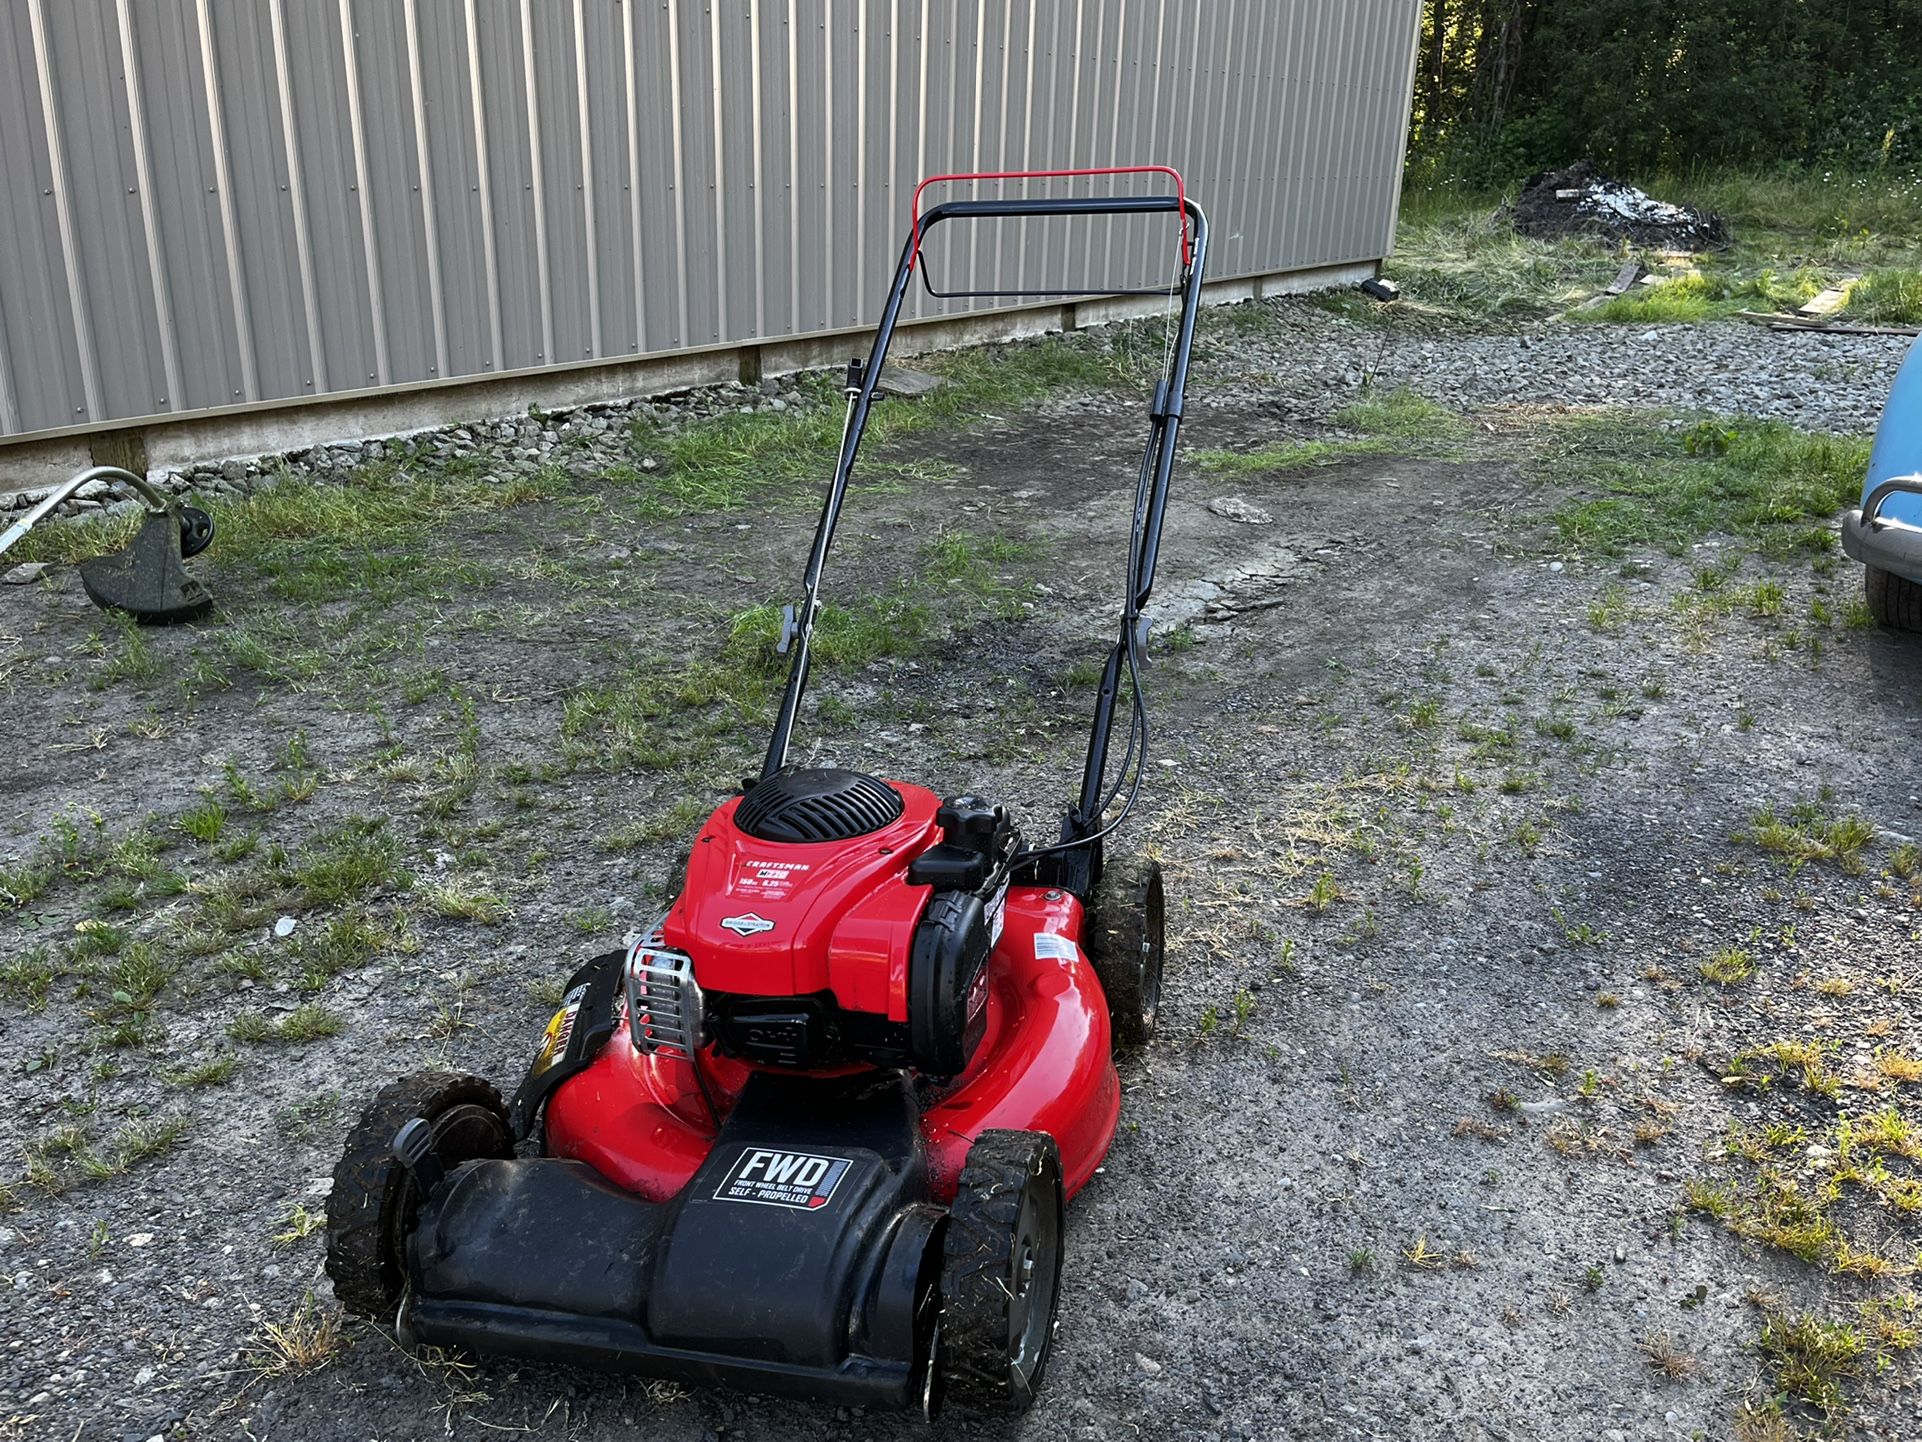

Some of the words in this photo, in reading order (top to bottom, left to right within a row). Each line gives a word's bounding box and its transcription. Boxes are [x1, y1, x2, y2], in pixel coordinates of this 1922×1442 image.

[746, 860, 810, 871] CRAFTSMAN
[553, 1011, 577, 1056] DANGER
[739, 1152, 829, 1187] FWD
[728, 1187, 752, 1196] SELF
[757, 1189, 809, 1204] PROPELLED
[734, 1179, 756, 1187] FRONT
[755, 1182, 775, 1190] WHEEL
[776, 1183, 793, 1191] BELT
[793, 1186, 813, 1195] DRIVE
